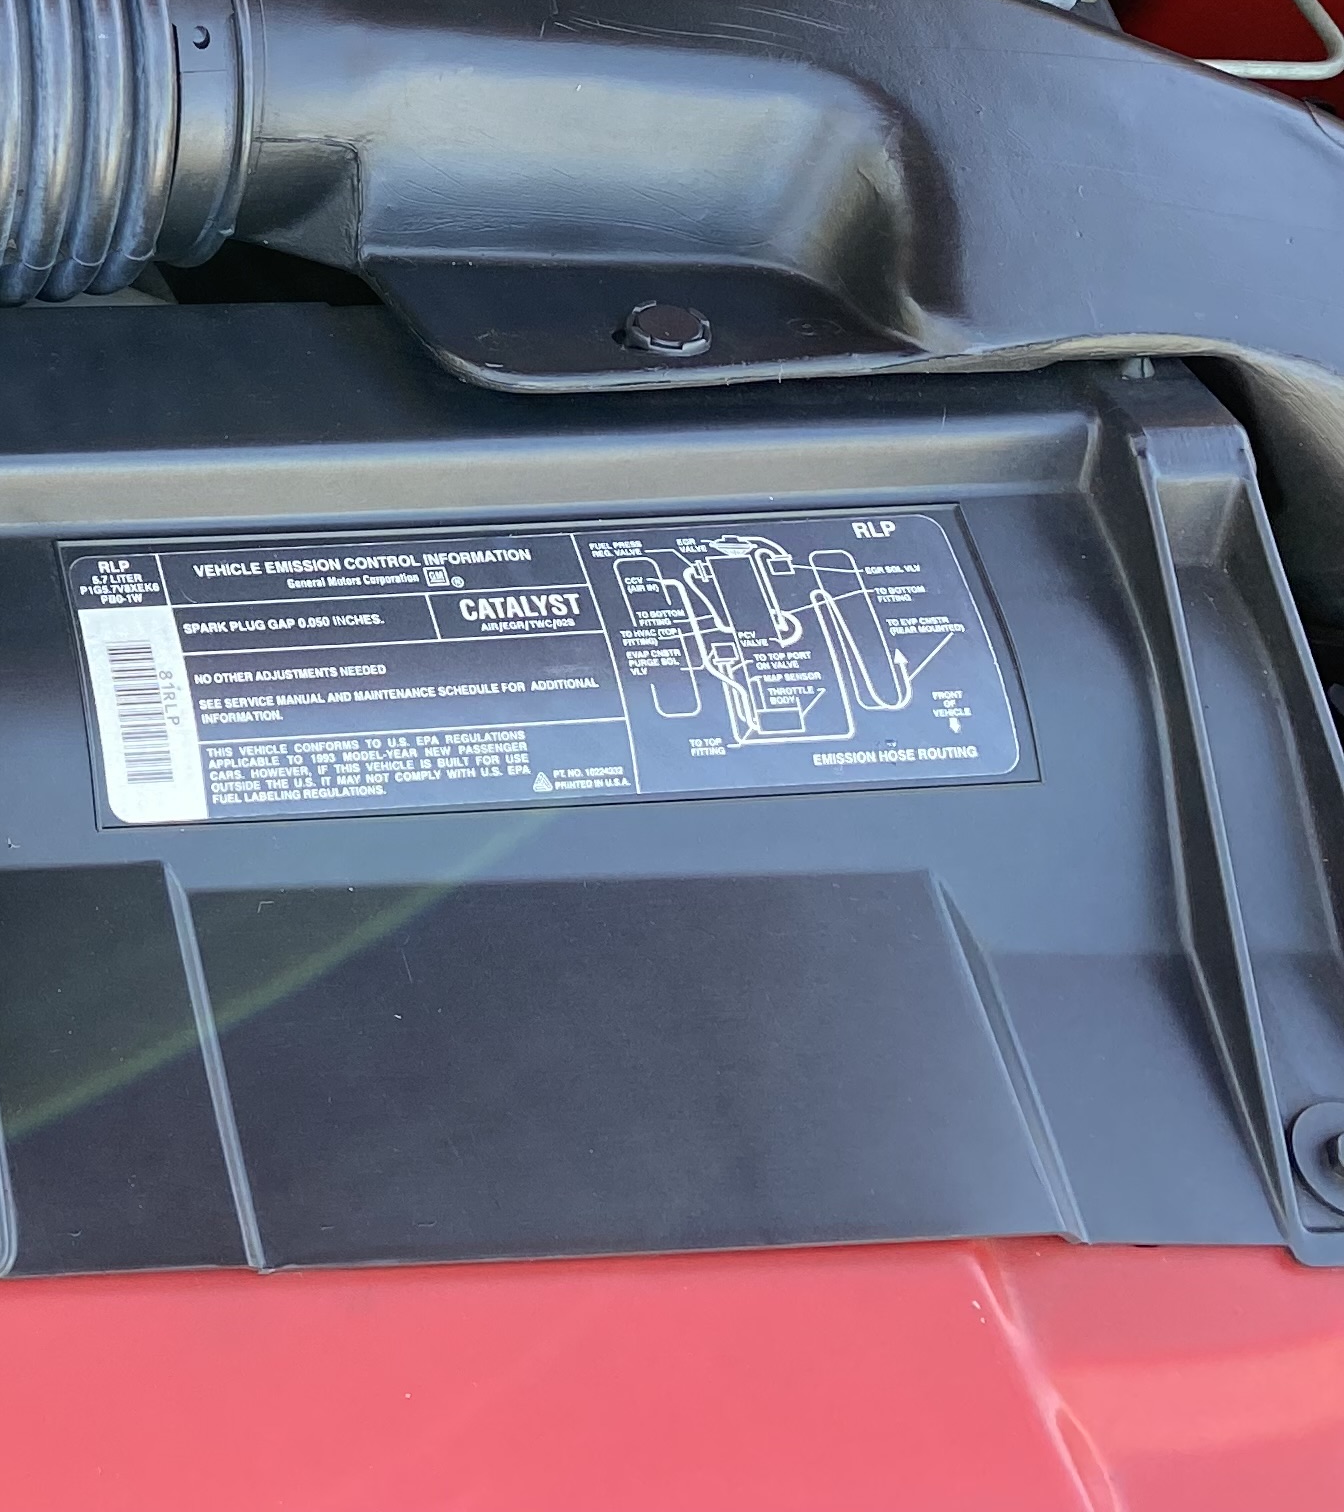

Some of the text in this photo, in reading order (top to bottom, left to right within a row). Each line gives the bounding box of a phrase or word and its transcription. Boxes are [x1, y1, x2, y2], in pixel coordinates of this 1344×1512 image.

[853, 522, 896, 538] RLP
[98, 560, 130, 573] RLP
[193, 549, 531, 578] VEHICLE EMISSION CONTROL INFORMATION
[287, 577, 326, 589] General
[327, 576, 362, 586] Motors
[363, 573, 419, 586] Corporation
[459, 593, 580, 621] CATALYST
[183, 614, 385, 634] SPARK PLUG GAP 0.050 INCHES.
[194, 664, 386, 684] NO OTHER ADJUSTMENTS NEEDED
[813, 746, 978, 766] EMISSION HOSE ROUTING
